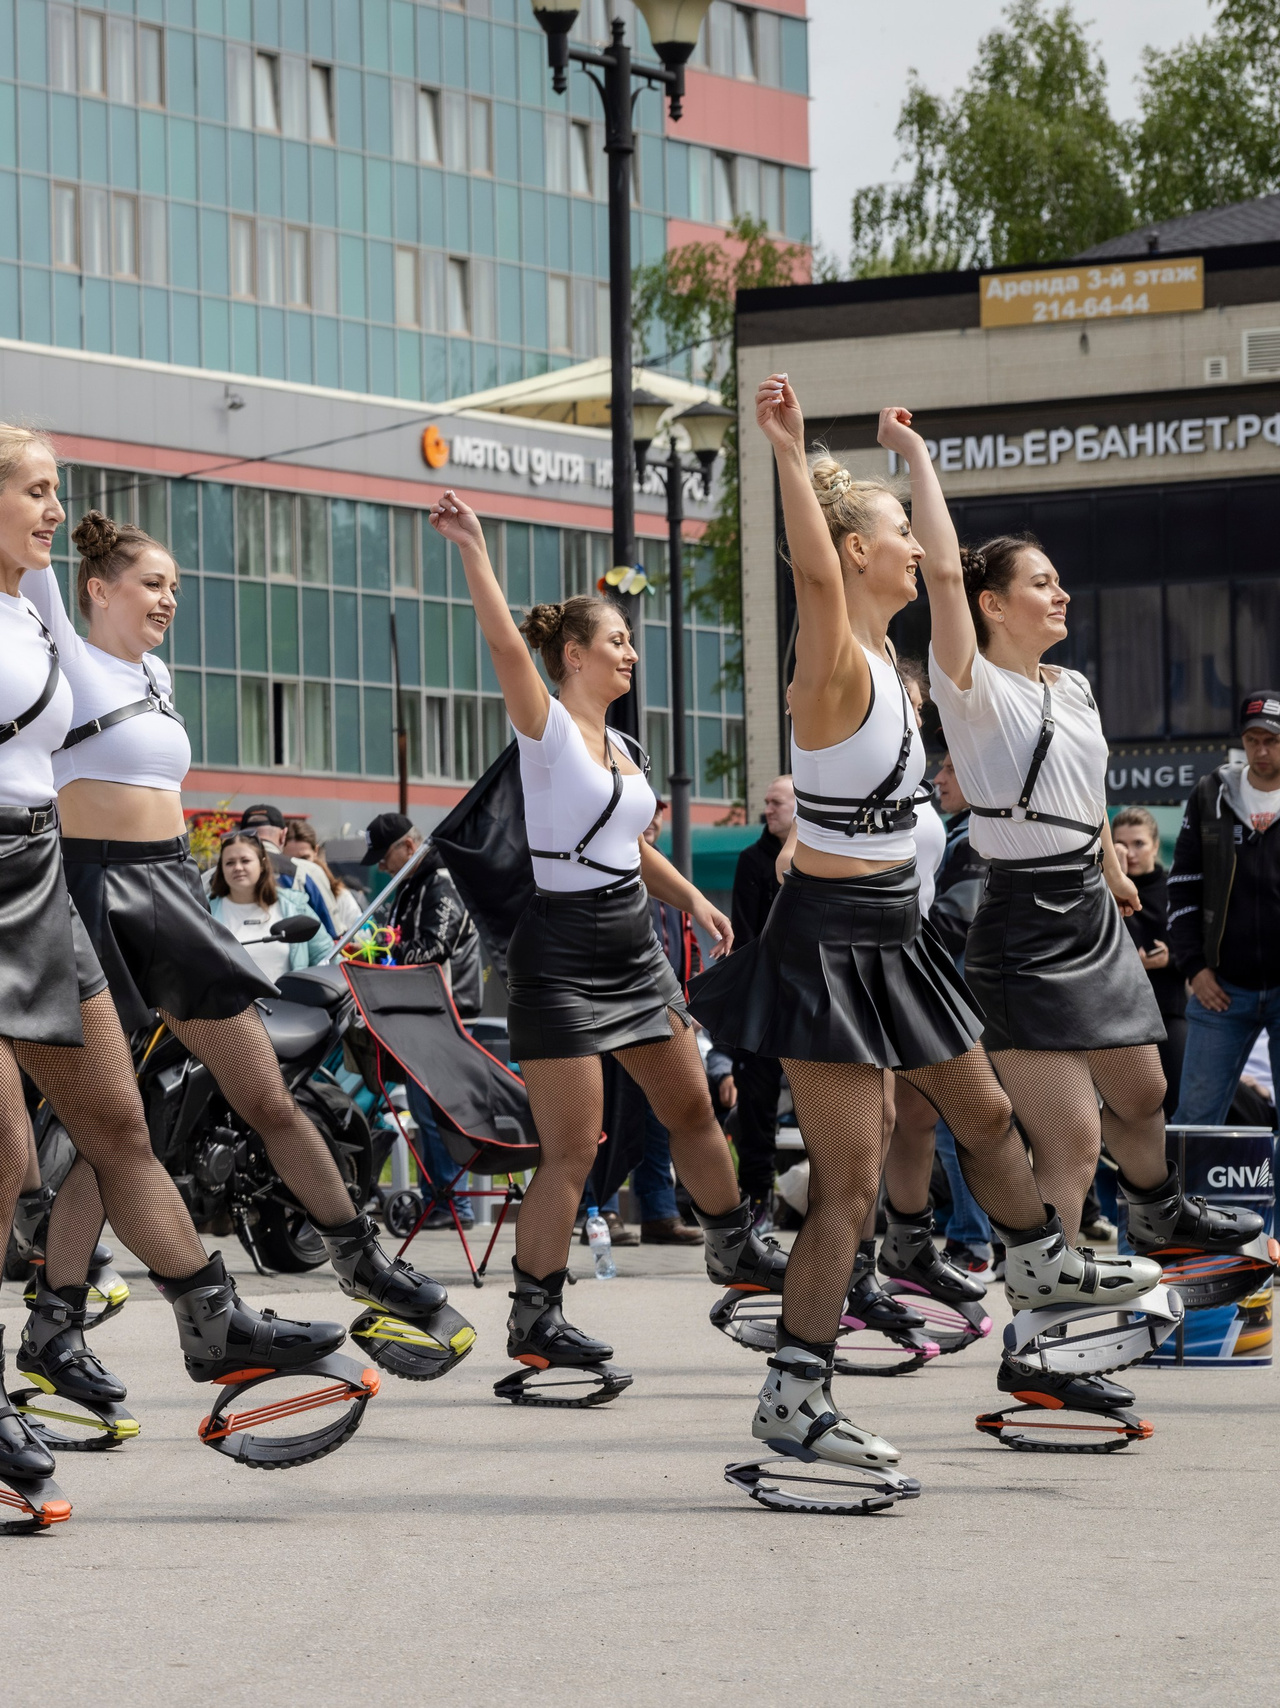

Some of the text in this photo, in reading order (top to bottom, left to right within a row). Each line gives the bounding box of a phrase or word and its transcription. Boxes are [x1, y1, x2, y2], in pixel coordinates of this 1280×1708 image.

[986, 265, 1197, 301] Аренда 3-й этаж
[1032, 293, 1150, 322] 214-64-44
[888, 412, 1280, 476] ЕМЬЕРБАНКЕТ.РФ
[1107, 764, 1195, 790] UNGE
